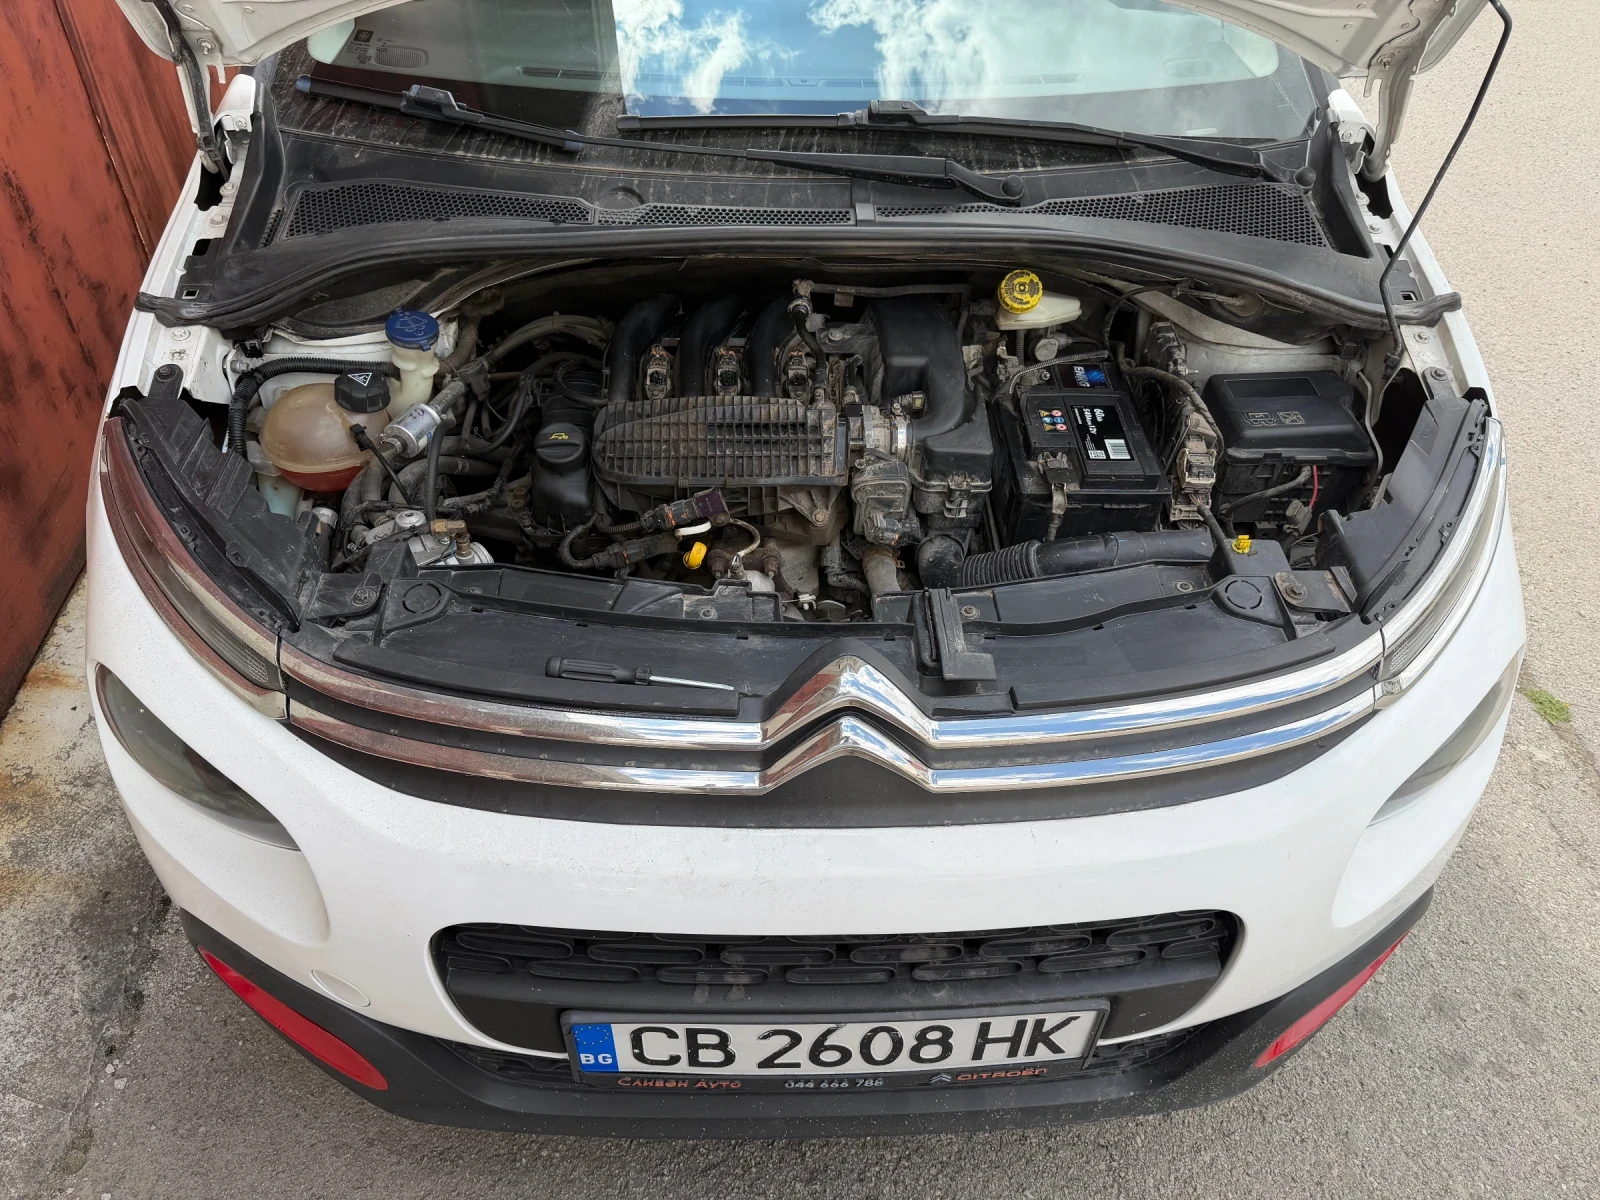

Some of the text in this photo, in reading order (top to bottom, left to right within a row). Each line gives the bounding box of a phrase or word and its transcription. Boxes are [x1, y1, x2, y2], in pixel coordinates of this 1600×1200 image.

[756, 1024, 954, 1069] 2608
[580, 1053, 613, 1064] BG
[784, 1079, 815, 1089] 044
[820, 1078, 849, 1088] 666
